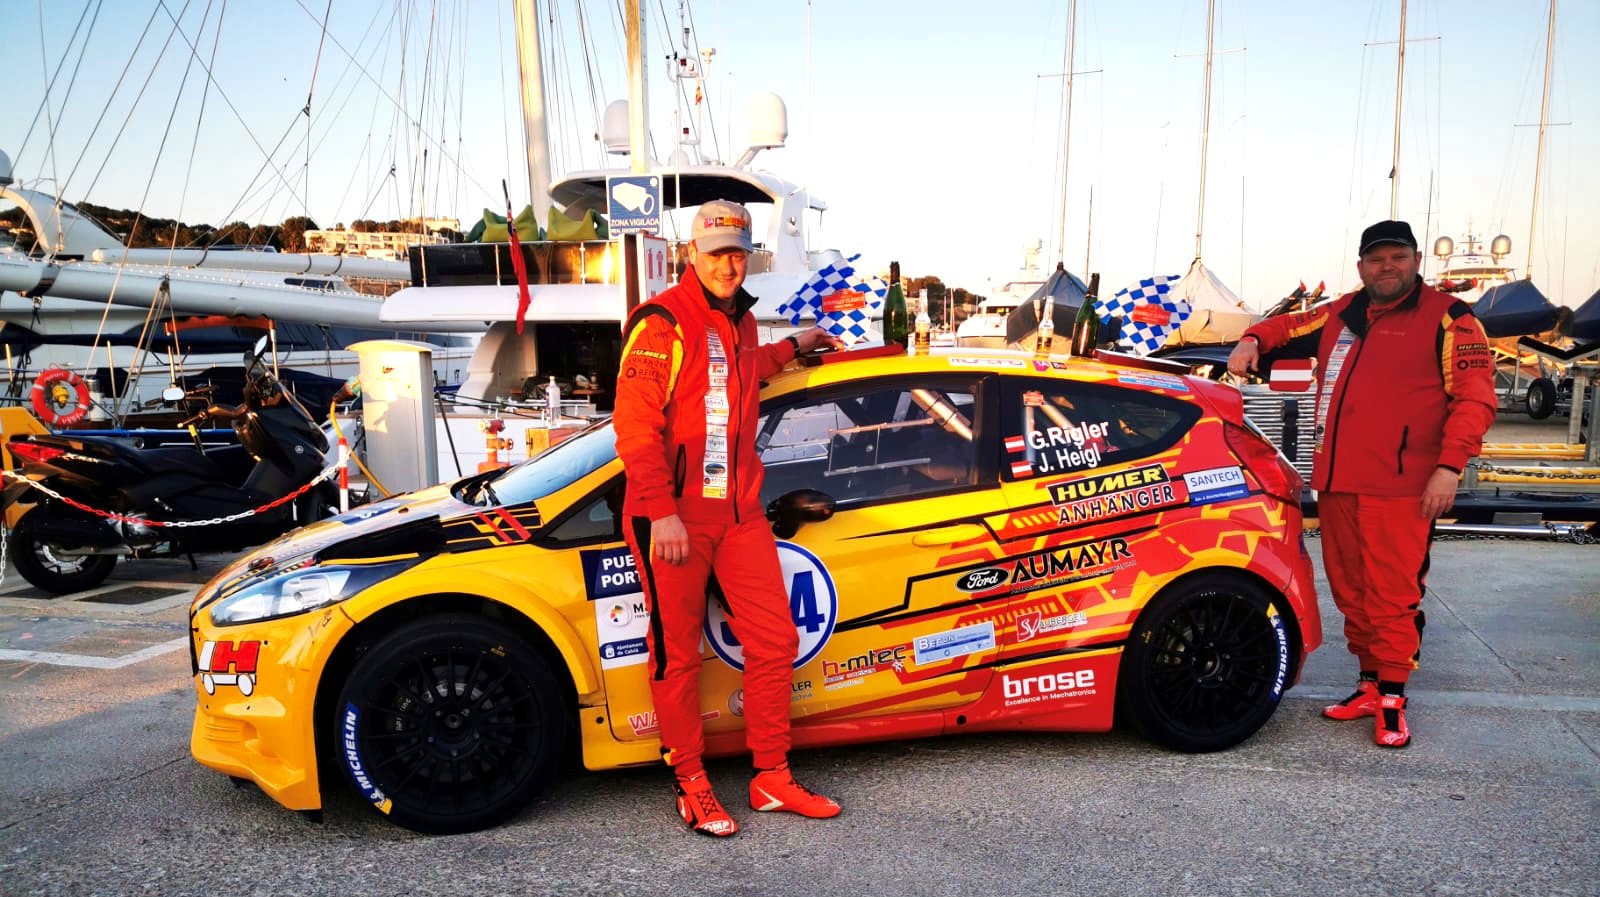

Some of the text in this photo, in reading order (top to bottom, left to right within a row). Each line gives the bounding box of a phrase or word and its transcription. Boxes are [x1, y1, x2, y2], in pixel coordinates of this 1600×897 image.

[1028, 421, 1109, 450] G.Rigler
[1038, 444, 1102, 473] J. Heigl
[1056, 466, 1163, 502] HUMER
[1190, 471, 1240, 487] SANTECH
[1058, 485, 1175, 525] ANHÄNGER
[1011, 538, 1132, 585] AUMAYR
[966, 570, 999, 590] Ford
[822, 646, 906, 676] h-mtec
[1273, 628, 1288, 696] MICHELIN
[1002, 669, 1095, 699] brose
[1005, 695, 1041, 707] Excellence
[1050, 688, 1096, 699] Mechatronics
[345, 711, 372, 790] MICHELIN
